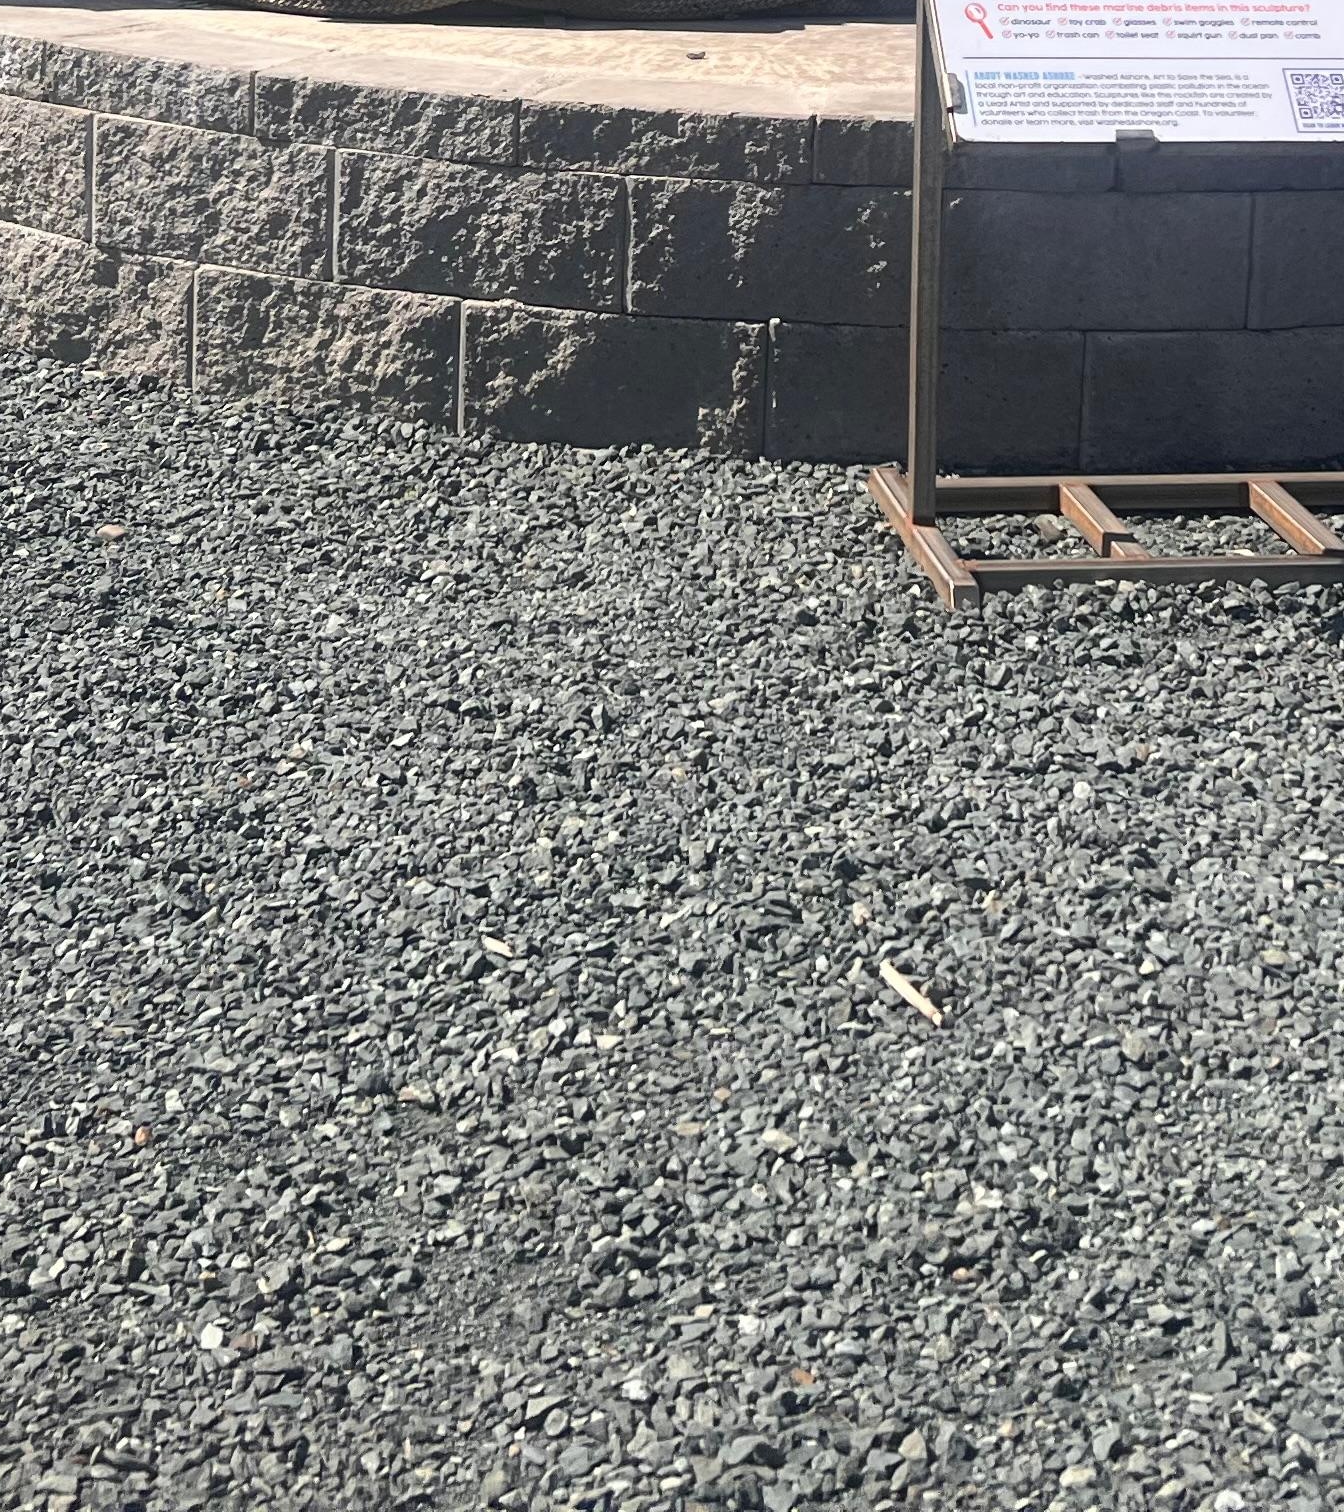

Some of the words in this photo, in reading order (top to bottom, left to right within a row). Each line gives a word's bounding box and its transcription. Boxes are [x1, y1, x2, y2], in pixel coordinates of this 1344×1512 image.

[997, 3, 1020, 11] Can
[1021, 4, 1044, 13] you
[1045, 3, 1068, 12] find
[1069, 3, 1101, 12] these
[1102, 3, 1145, 12] marine
[1146, 3, 1183, 12] debris
[1184, 4, 1216, 12] items
[1216, 3, 1229, 12] in
[1229, 3, 1250, 12] this
[1251, 4, 1310, 13] sculpture?
[1003, 72, 1040, 80] WASHED
[1042, 72, 1076, 81] ASHORE
